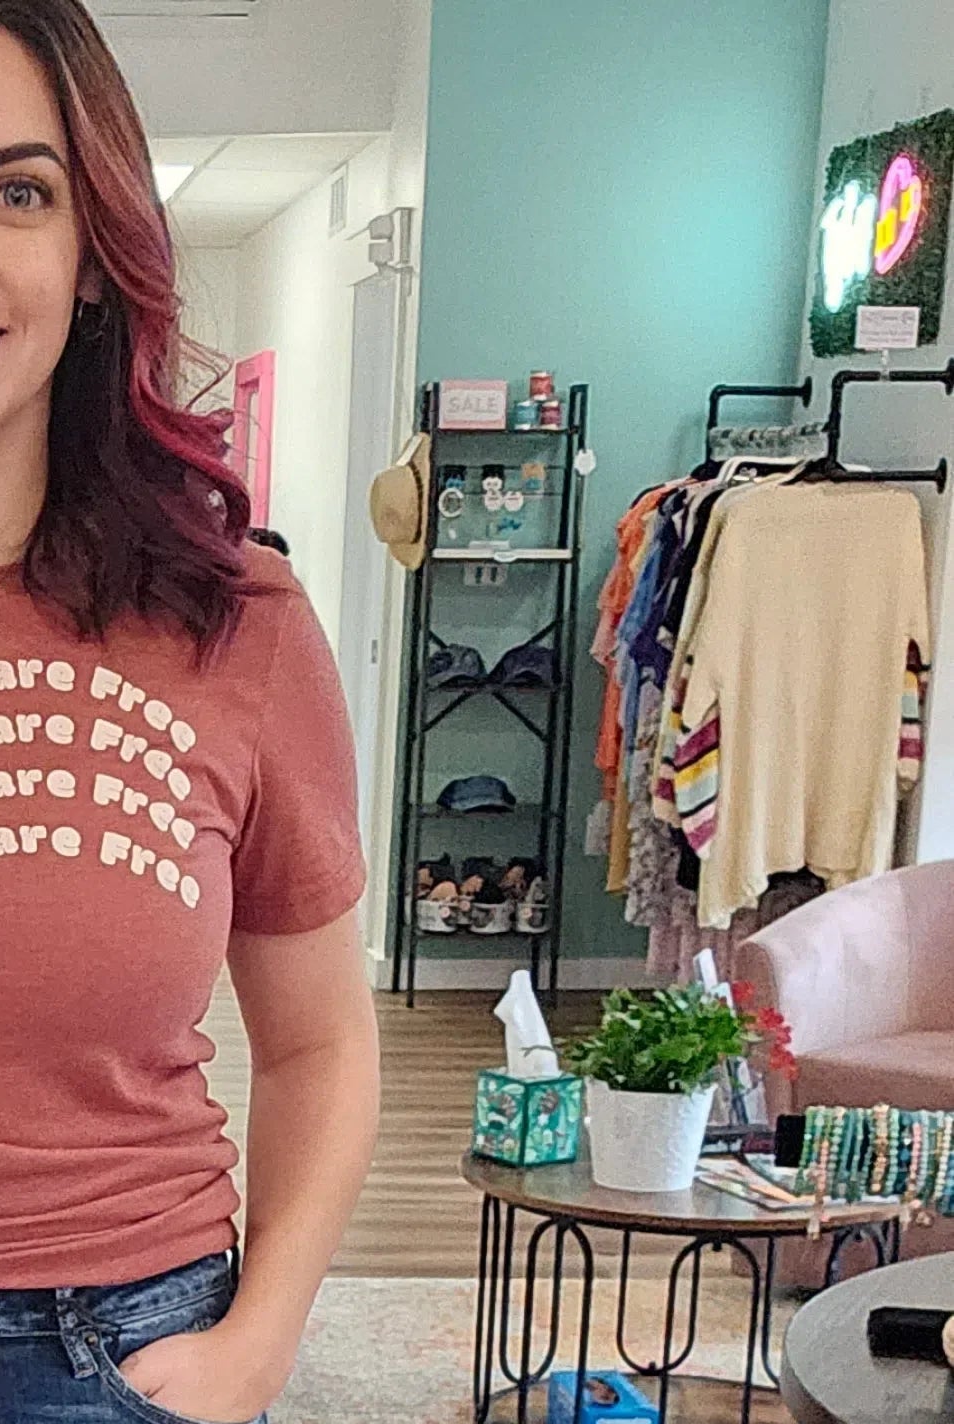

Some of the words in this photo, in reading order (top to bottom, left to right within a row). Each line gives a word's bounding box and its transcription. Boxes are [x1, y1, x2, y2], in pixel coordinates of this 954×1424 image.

[448, 397, 499, 413] SALE
[90, 666, 196, 753] Free
[90, 718, 191, 800] Free
[93, 773, 195, 849] Free
[100, 831, 200, 909] Free
